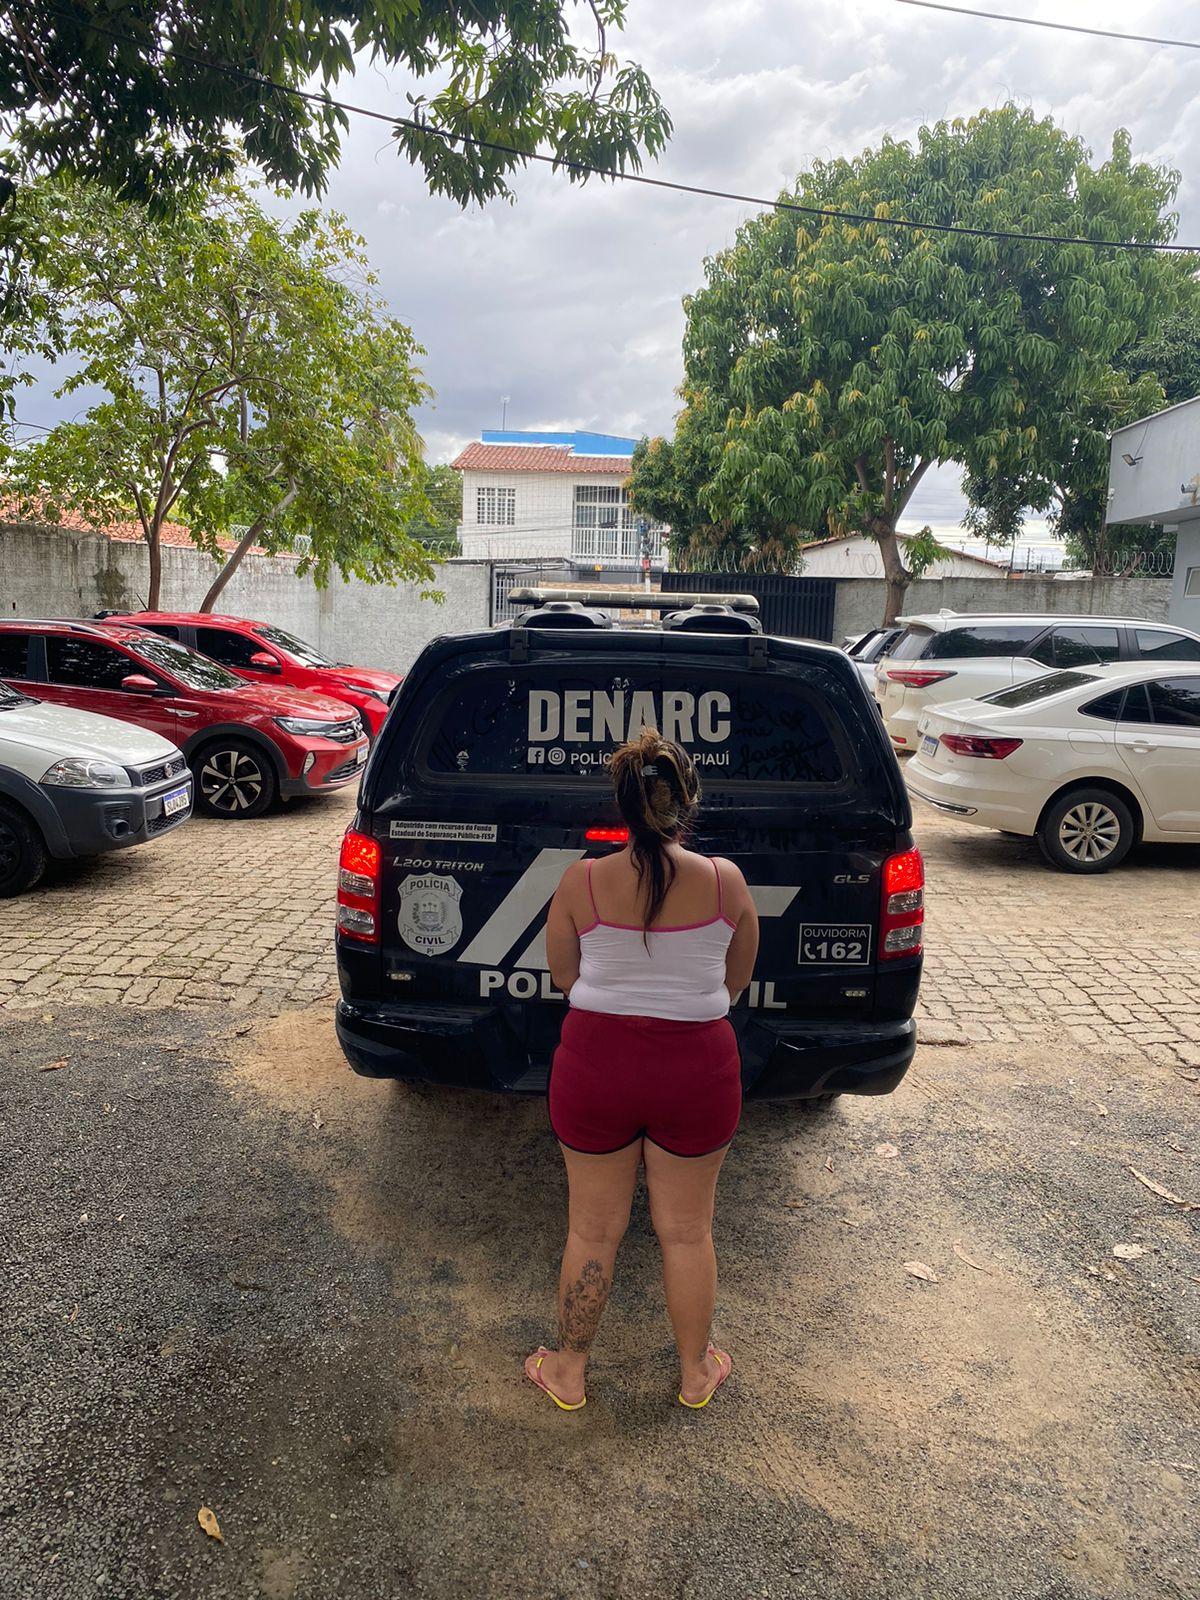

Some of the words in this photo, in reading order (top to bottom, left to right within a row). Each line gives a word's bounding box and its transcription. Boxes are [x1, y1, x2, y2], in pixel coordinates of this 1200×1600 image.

[528, 690, 731, 743] DENARC
[571, 750, 613, 765] POLÍC
[692, 750, 730, 765] PIAUÍ
[395, 821, 424, 829] Adquirido
[391, 829, 416, 837] Estadual
[392, 856, 432, 869] L200
[435, 860, 485, 872] TRITON
[410, 878, 450, 892] POLÍCIA
[833, 874, 871, 884] GLS
[803, 928, 867, 938] OUVIDORIA
[414, 935, 446, 945] CIVIL
[816, 941, 862, 960] 162
